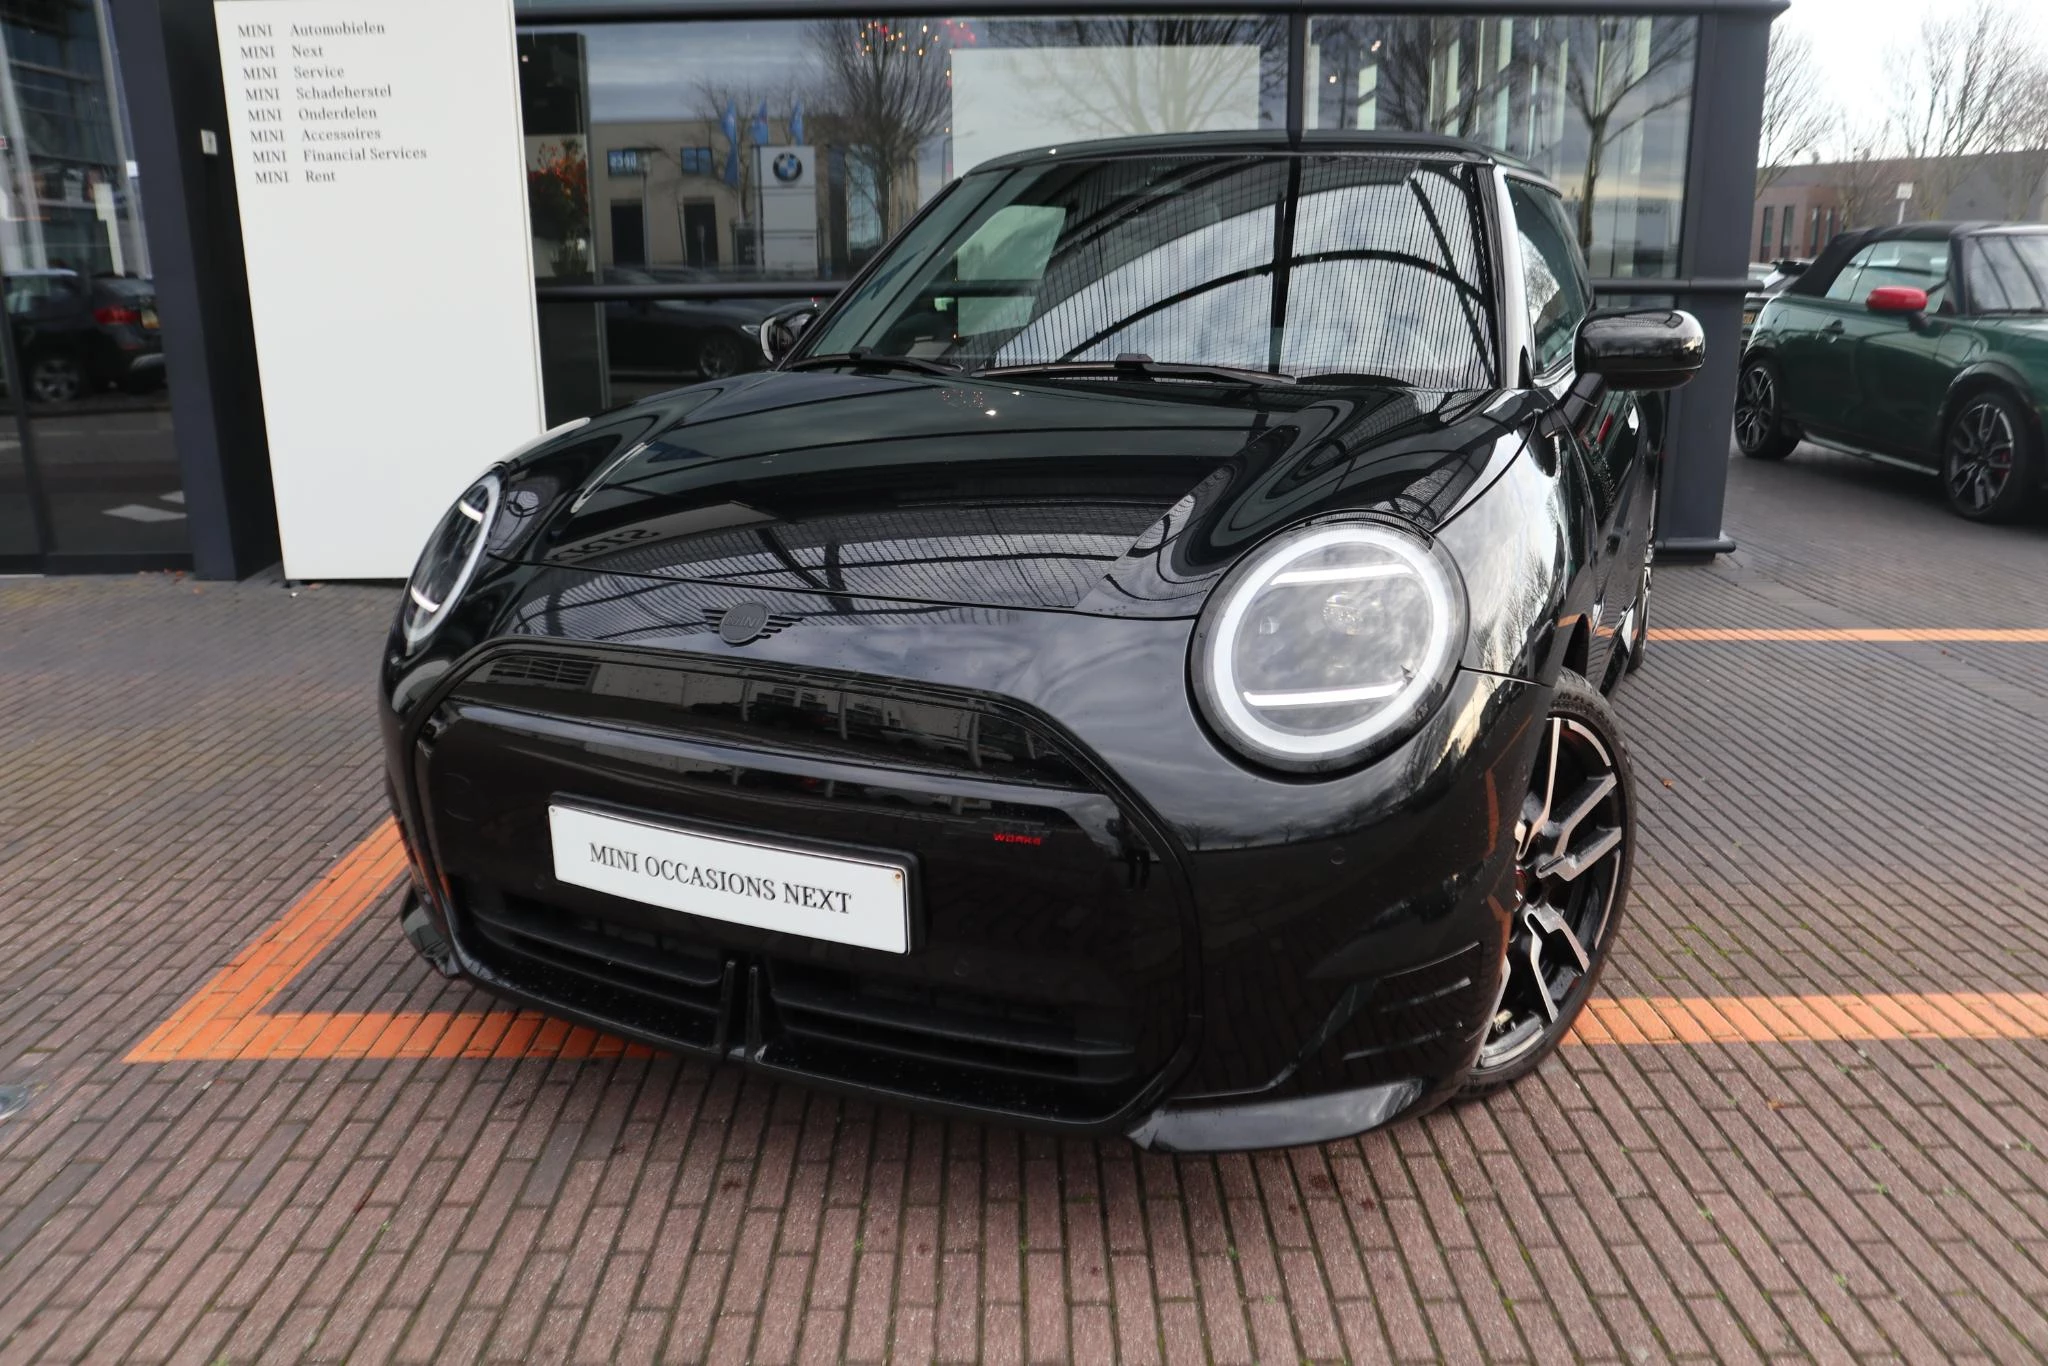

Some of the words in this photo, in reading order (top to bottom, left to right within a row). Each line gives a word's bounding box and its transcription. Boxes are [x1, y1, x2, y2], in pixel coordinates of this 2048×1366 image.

[237, 24, 273, 38] MINI
[290, 20, 385, 37] Automobielen
[240, 45, 275, 59] MINI
[292, 44, 323, 58] Next
[243, 66, 277, 80] MINI
[294, 65, 344, 79] Service
[245, 87, 280, 101] MINI
[296, 84, 391, 100] Schadeherstel
[248, 108, 282, 122] MINI
[299, 105, 377, 120] Onderdelen
[250, 129, 284, 143] MINI
[302, 127, 381, 142] Accessoires
[253, 150, 287, 163] MINI
[304, 148, 365, 162] Financial
[370, 146, 427, 160] Services
[255, 171, 289, 184] MINI
[306, 169, 335, 183] Rent
[993, 833, 1042, 846] WORKS
[589, 842, 639, 873] MINI
[645, 856, 776, 901] OCCASIONS
[783, 882, 852, 914] NEXT
